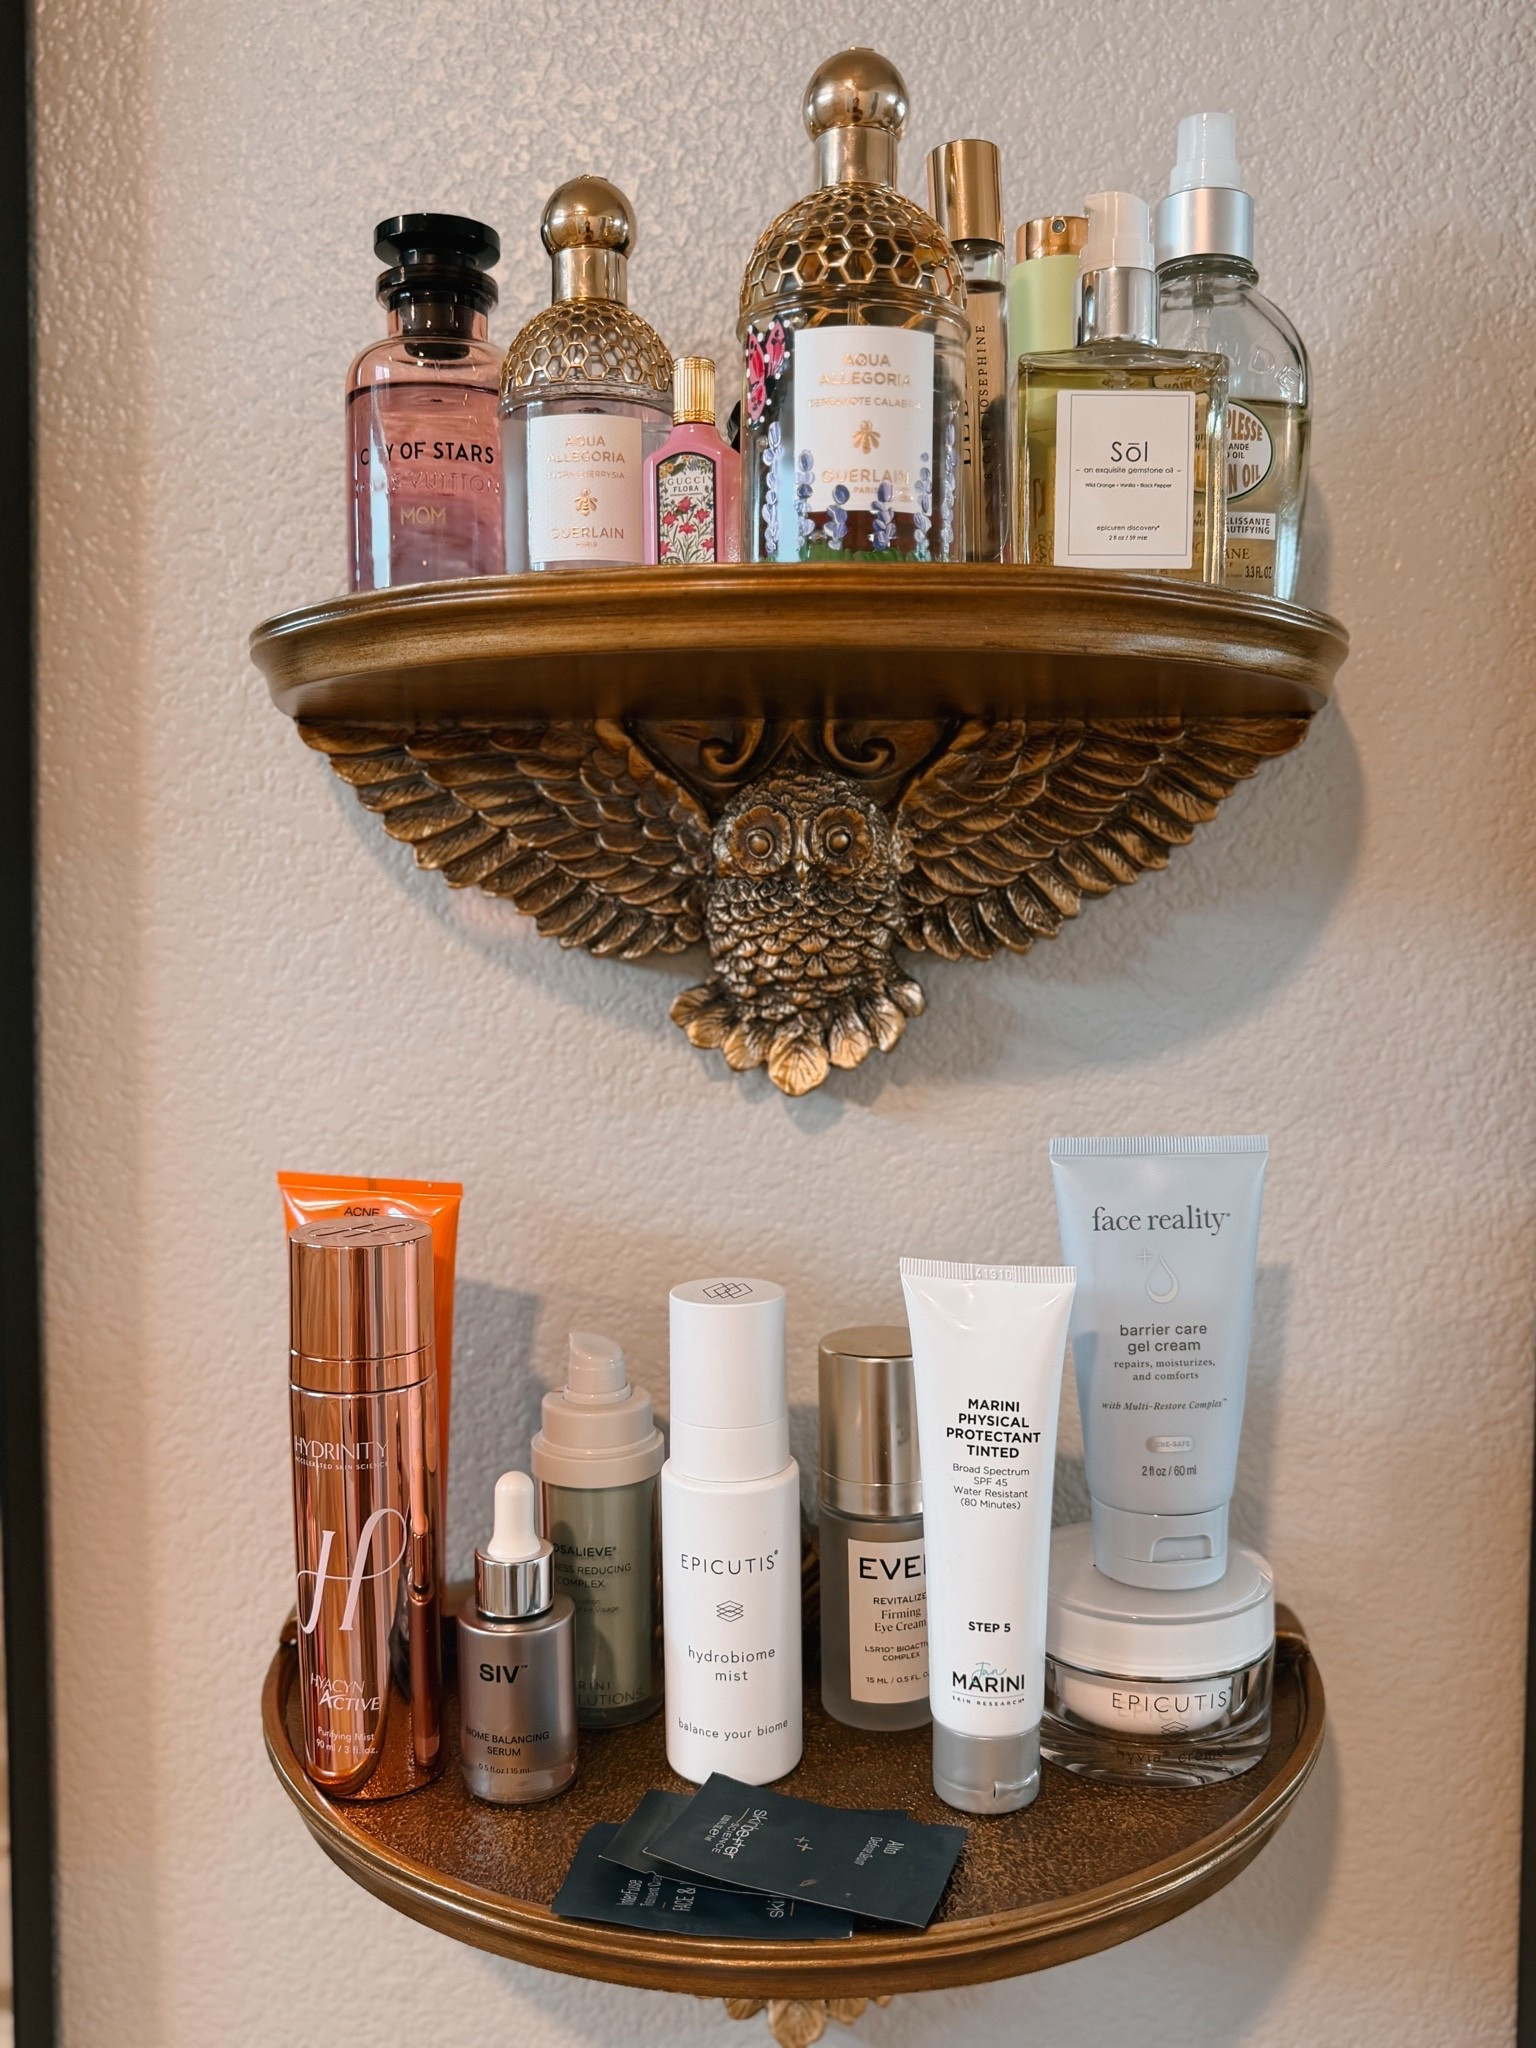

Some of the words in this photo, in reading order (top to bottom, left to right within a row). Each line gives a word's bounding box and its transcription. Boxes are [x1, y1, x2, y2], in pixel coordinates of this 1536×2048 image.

[844, 353, 891, 367] AQUA
[975, 324, 990, 415] JOSEPHINE
[819, 371, 912, 387] ALLEGORIA
[360, 443, 395, 465] CY
[400, 441, 426, 460] OF
[433, 441, 494, 464] STARS
[1228, 442, 1250, 451] ANDE
[546, 450, 625, 463] ALLEGORIA
[1232, 451, 1245, 459] OIL
[821, 468, 910, 485] GUERLAIN
[1095, 466, 1126, 475] exquisite
[1127, 467, 1164, 475] gemstone
[1165, 466, 1174, 474] oil
[1242, 464, 1261, 488] OIL
[667, 476, 705, 486] GUCCI
[673, 485, 699, 493] FLORA
[400, 506, 446, 525] MOM
[550, 526, 624, 539] GUERLAIN
[1225, 525, 1270, 535] AUTIFYING
[1244, 565, 1254, 578] 3.3
[1264, 566, 1272, 579] OZ
[1091, 1205, 1142, 1232] face
[1119, 1323, 1170, 1336] barrier
[1174, 1324, 1208, 1335] care
[1127, 1340, 1150, 1355] gel
[1154, 1340, 1201, 1352] cream
[1113, 1360, 1153, 1370] repairs,
[1155, 1358, 1216, 1368] moisturizes,
[1132, 1372, 1152, 1381] and
[1154, 1371, 1199, 1381] comforts
[967, 1398, 1021, 1413] MARINI
[1102, 1400, 1122, 1410] with
[1123, 1400, 1187, 1411] Multi-Restore
[958, 1413, 1030, 1428] PHYSICAL
[946, 1427, 1041, 1443] PROTECTANT
[293, 1434, 390, 1461] HYDRINITY
[966, 1444, 1020, 1459] TINTED
[952, 1463, 981, 1474] Broad
[983, 1466, 1030, 1477] Spectrum
[1141, 1465, 1148, 1476] 2
[1149, 1465, 1155, 1476] fl
[1155, 1466, 1167, 1476] oz
[1173, 1465, 1186, 1476] 60
[1186, 1465, 1197, 1475] ml
[973, 1476, 992, 1486] SPF
[995, 1478, 1008, 1487] 45
[953, 1485, 981, 1496] Water
[984, 1488, 1028, 1499] Resistant
[960, 1497, 977, 1508] (80
[979, 1499, 1021, 1510] Minutes)
[577, 1562, 631, 1575] REDUCING
[859, 1554, 928, 1580] EVE
[556, 1575, 606, 1589] COMPLEX
[881, 1607, 922, 1620] Firming
[874, 1621, 894, 1634] Eye
[895, 1619, 928, 1632] Cream
[968, 1621, 1000, 1633] STEP
[1003, 1623, 1011, 1633] 5
[688, 1644, 776, 1663] hydrobiome
[896, 1641, 930, 1653] BIOACTIV
[882, 1652, 921, 1662] COMPLEX
[714, 1670, 749, 1682] mist
[971, 1661, 1008, 1682] Jan
[310, 1672, 365, 1694] HYACYN
[577, 1680, 611, 1691] RINI
[876, 1676, 888, 1684] ML
[952, 1671, 1025, 1693] MARINI
[319, 1688, 381, 1711] ACTIVE
[577, 1687, 645, 1706] LUTIONS
[952, 1695, 971, 1704] SKIN
[317, 1726, 352, 1743] Purifying
[355, 1733, 375, 1741] Mist
[465, 1725, 490, 1742] BIOME
[491, 1731, 550, 1744] BALANCING
[678, 1717, 719, 1738] balance
[724, 1728, 752, 1741] your
[757, 1718, 789, 1736] biome
[316, 1738, 325, 1749] 90
[326, 1743, 336, 1751] ml
[487, 1746, 521, 1756] SERUM
[711, 1822, 740, 1854] SCIENCE
[723, 1808, 769, 1859] skinbetter
[883, 1839, 905, 1855] Alto
[616, 1879, 643, 1906] InterFuse
[676, 1887, 697, 1895] &
[672, 1895, 695, 1912] FACE
